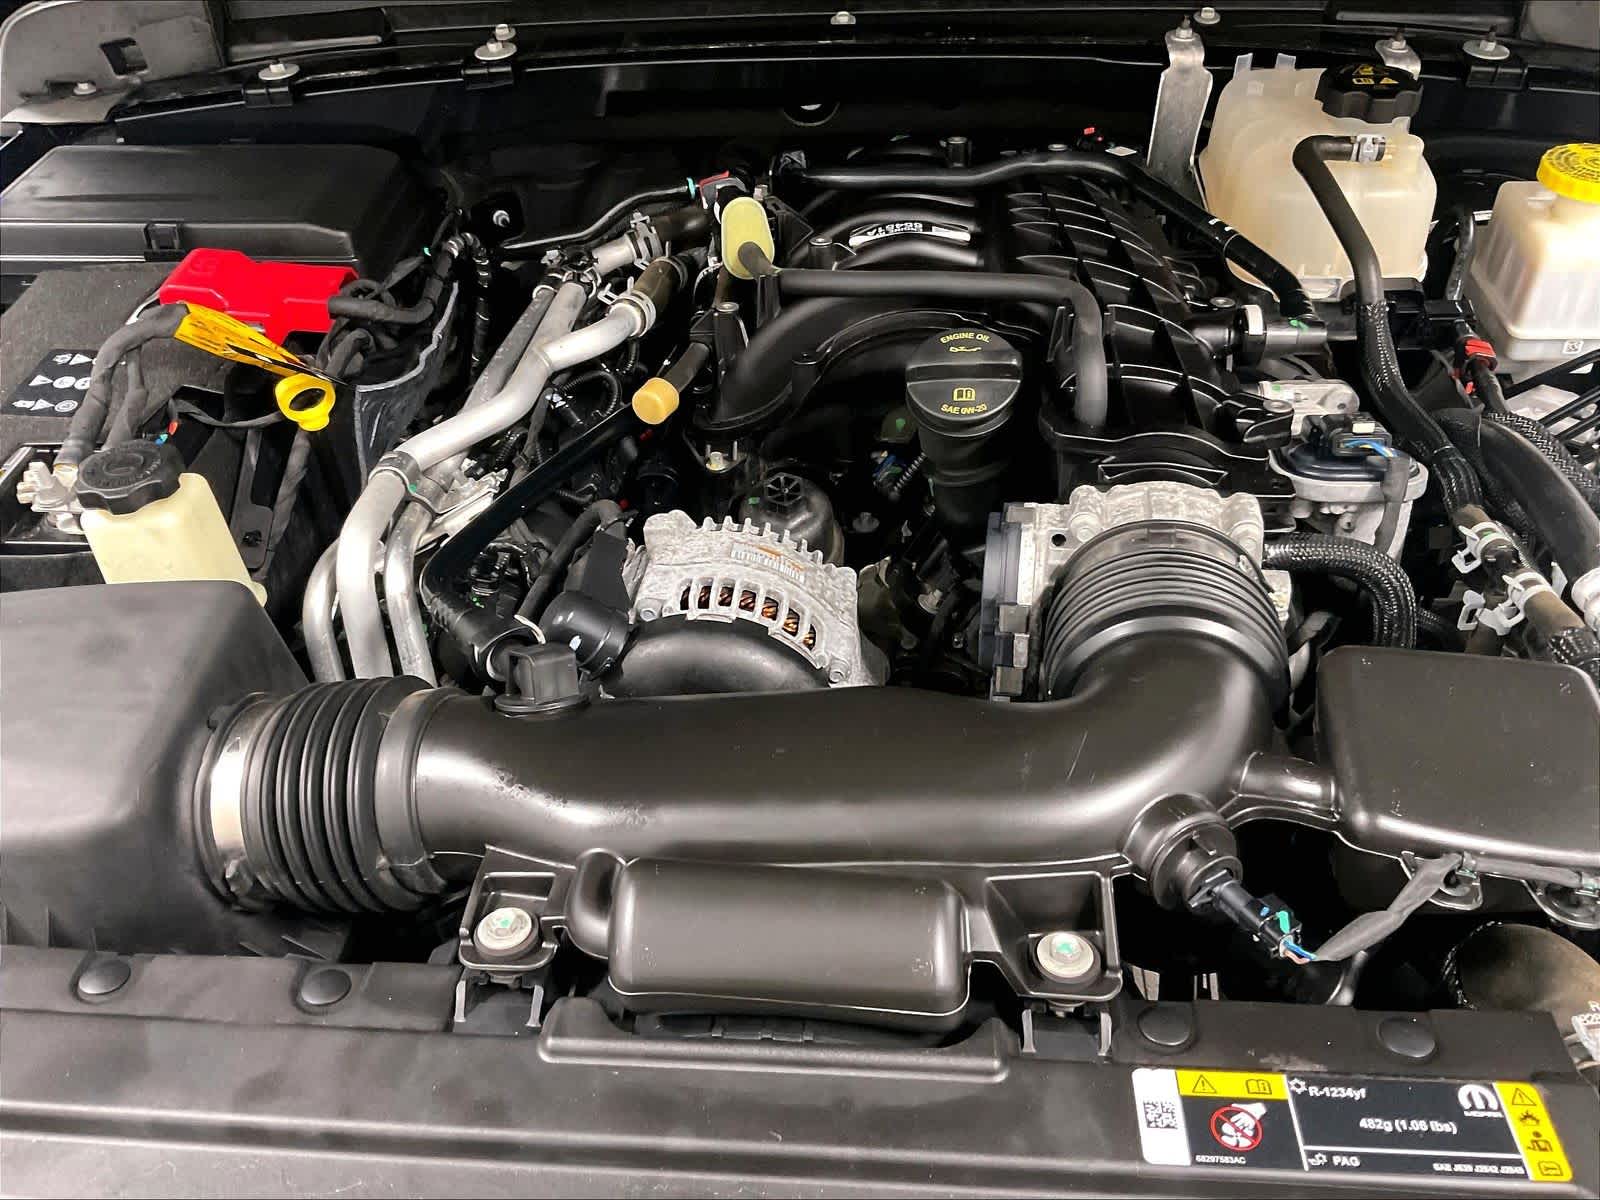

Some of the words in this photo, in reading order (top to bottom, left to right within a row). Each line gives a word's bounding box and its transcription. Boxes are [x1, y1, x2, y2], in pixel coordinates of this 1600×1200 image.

[940, 332, 975, 344] ENGINE
[976, 333, 990, 343] OIL
[941, 404, 960, 415] SAE
[1309, 1086, 1367, 1100] R-1234yf
[1359, 1117, 1393, 1132] 482g
[1430, 1121, 1458, 1135] lbs)
[1332, 1155, 1361, 1167] PAG
